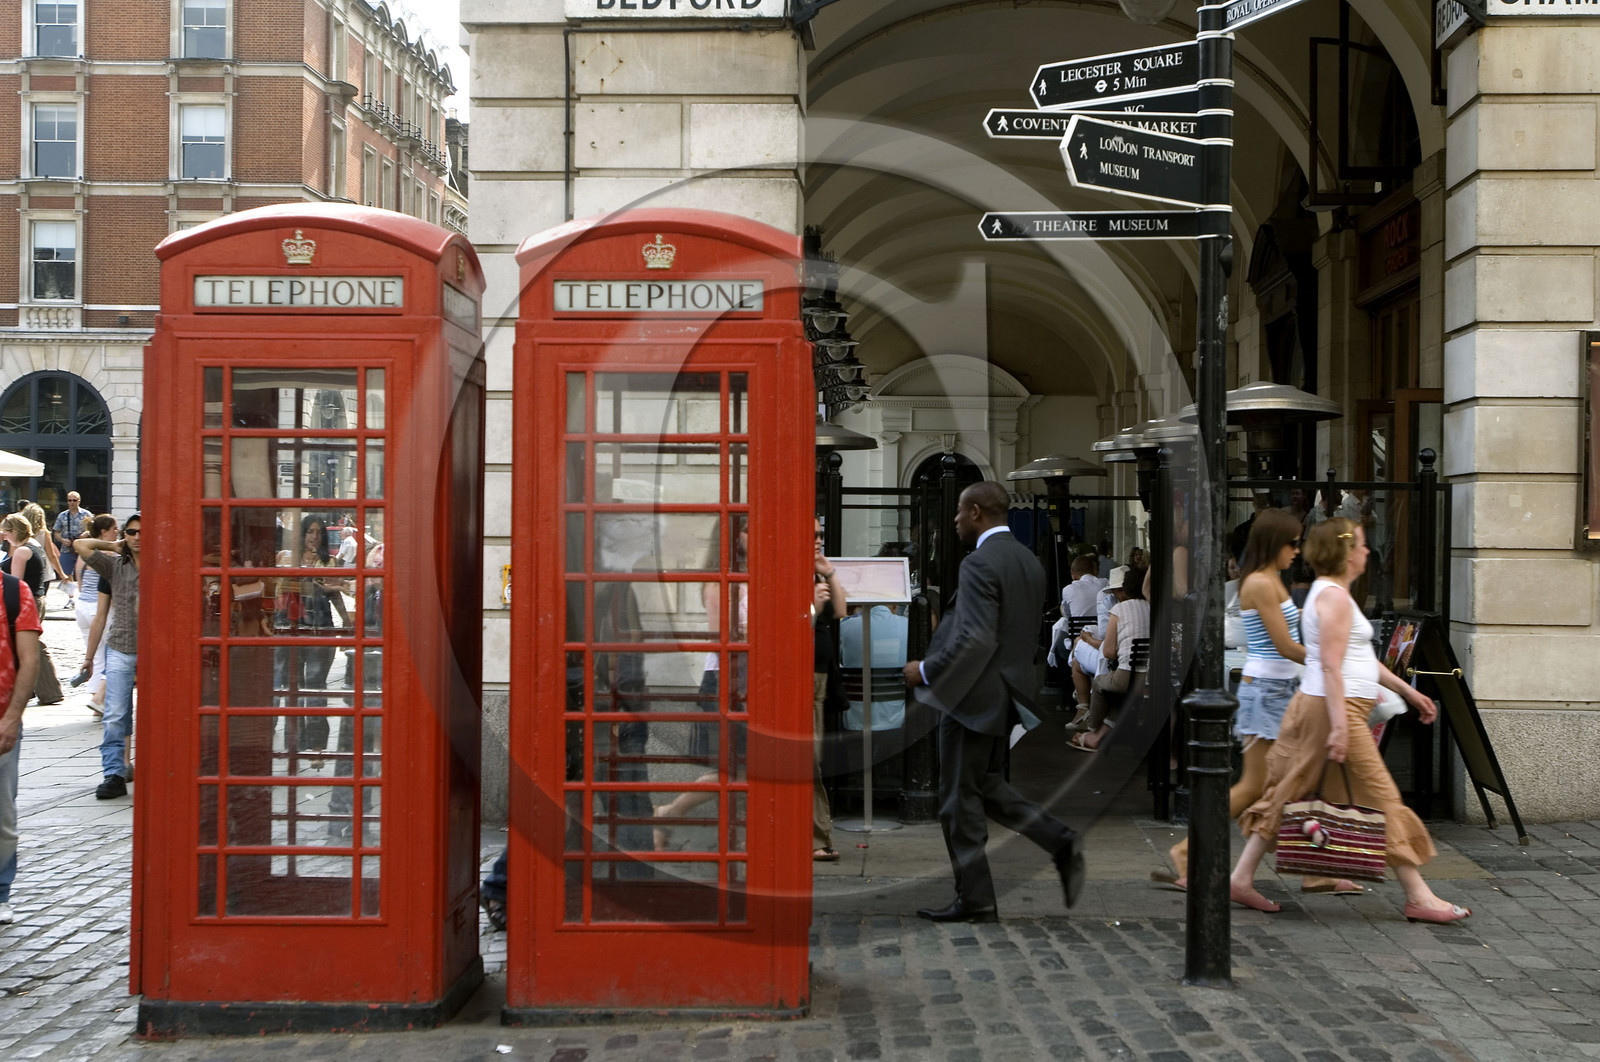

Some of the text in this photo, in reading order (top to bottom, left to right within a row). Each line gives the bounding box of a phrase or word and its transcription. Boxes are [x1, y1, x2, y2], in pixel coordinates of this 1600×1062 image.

[1226, 2, 1251, 23] ROYAL
[1060, 52, 1183, 83] LEICESTER SQUARE
[1113, 76, 1147, 91] 5 Min
[1013, 118, 1068, 131] COVENT
[1137, 121, 1197, 134] MARKET
[1099, 137, 1196, 167] LONDON TRANSPORT
[1099, 162, 1140, 180] MUSEUM
[1033, 219, 1169, 232] THEATRE MUSEUM
[203, 280, 397, 306] TELEPHONE
[560, 283, 755, 309] TELEPHONE
